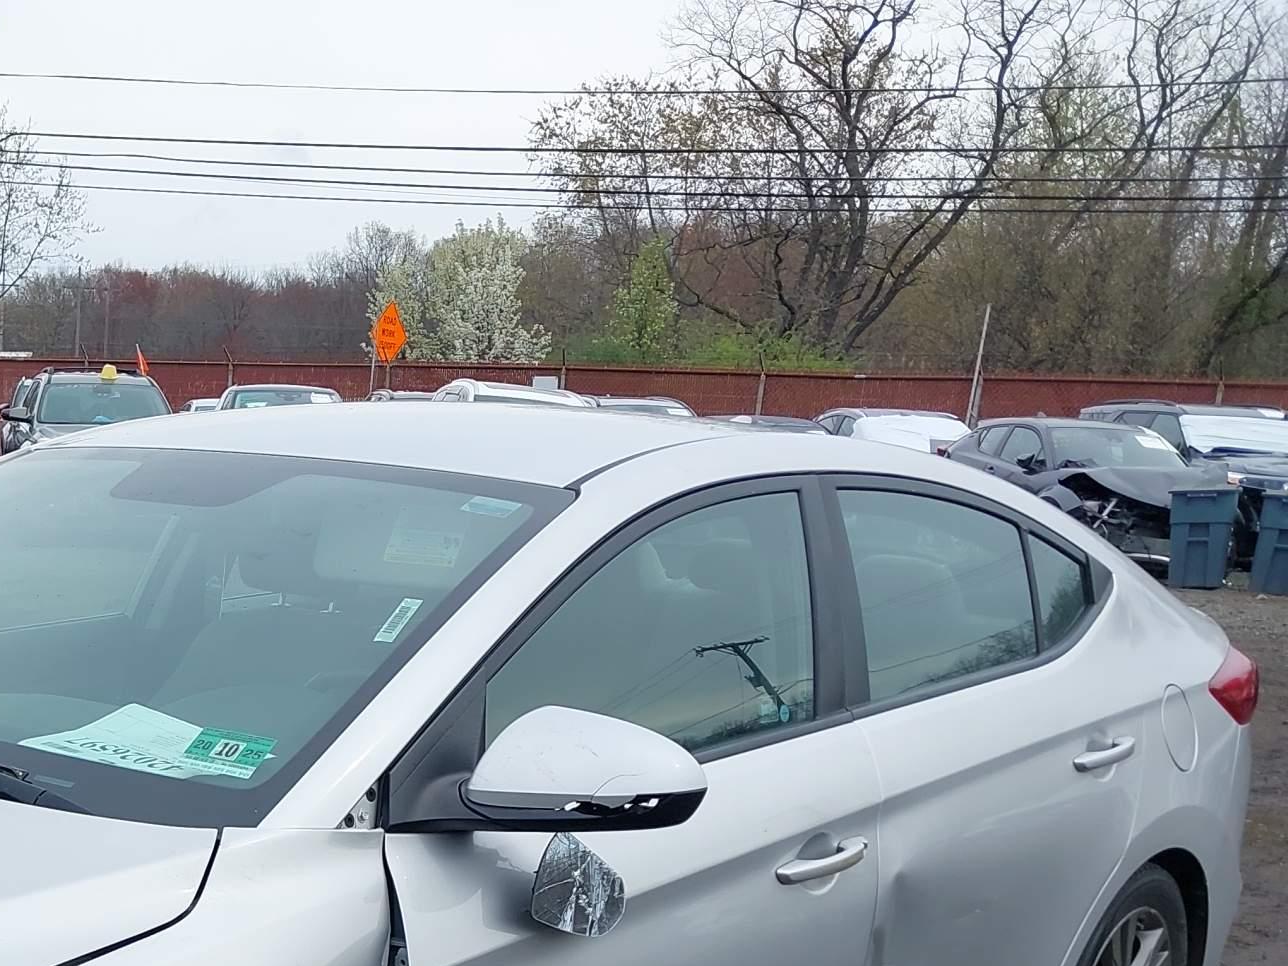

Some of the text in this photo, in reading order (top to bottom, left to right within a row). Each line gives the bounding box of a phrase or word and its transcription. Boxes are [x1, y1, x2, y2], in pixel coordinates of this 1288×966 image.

[193, 739, 213, 751] 20
[214, 742, 241, 758] 10
[242, 748, 264, 760] 25
